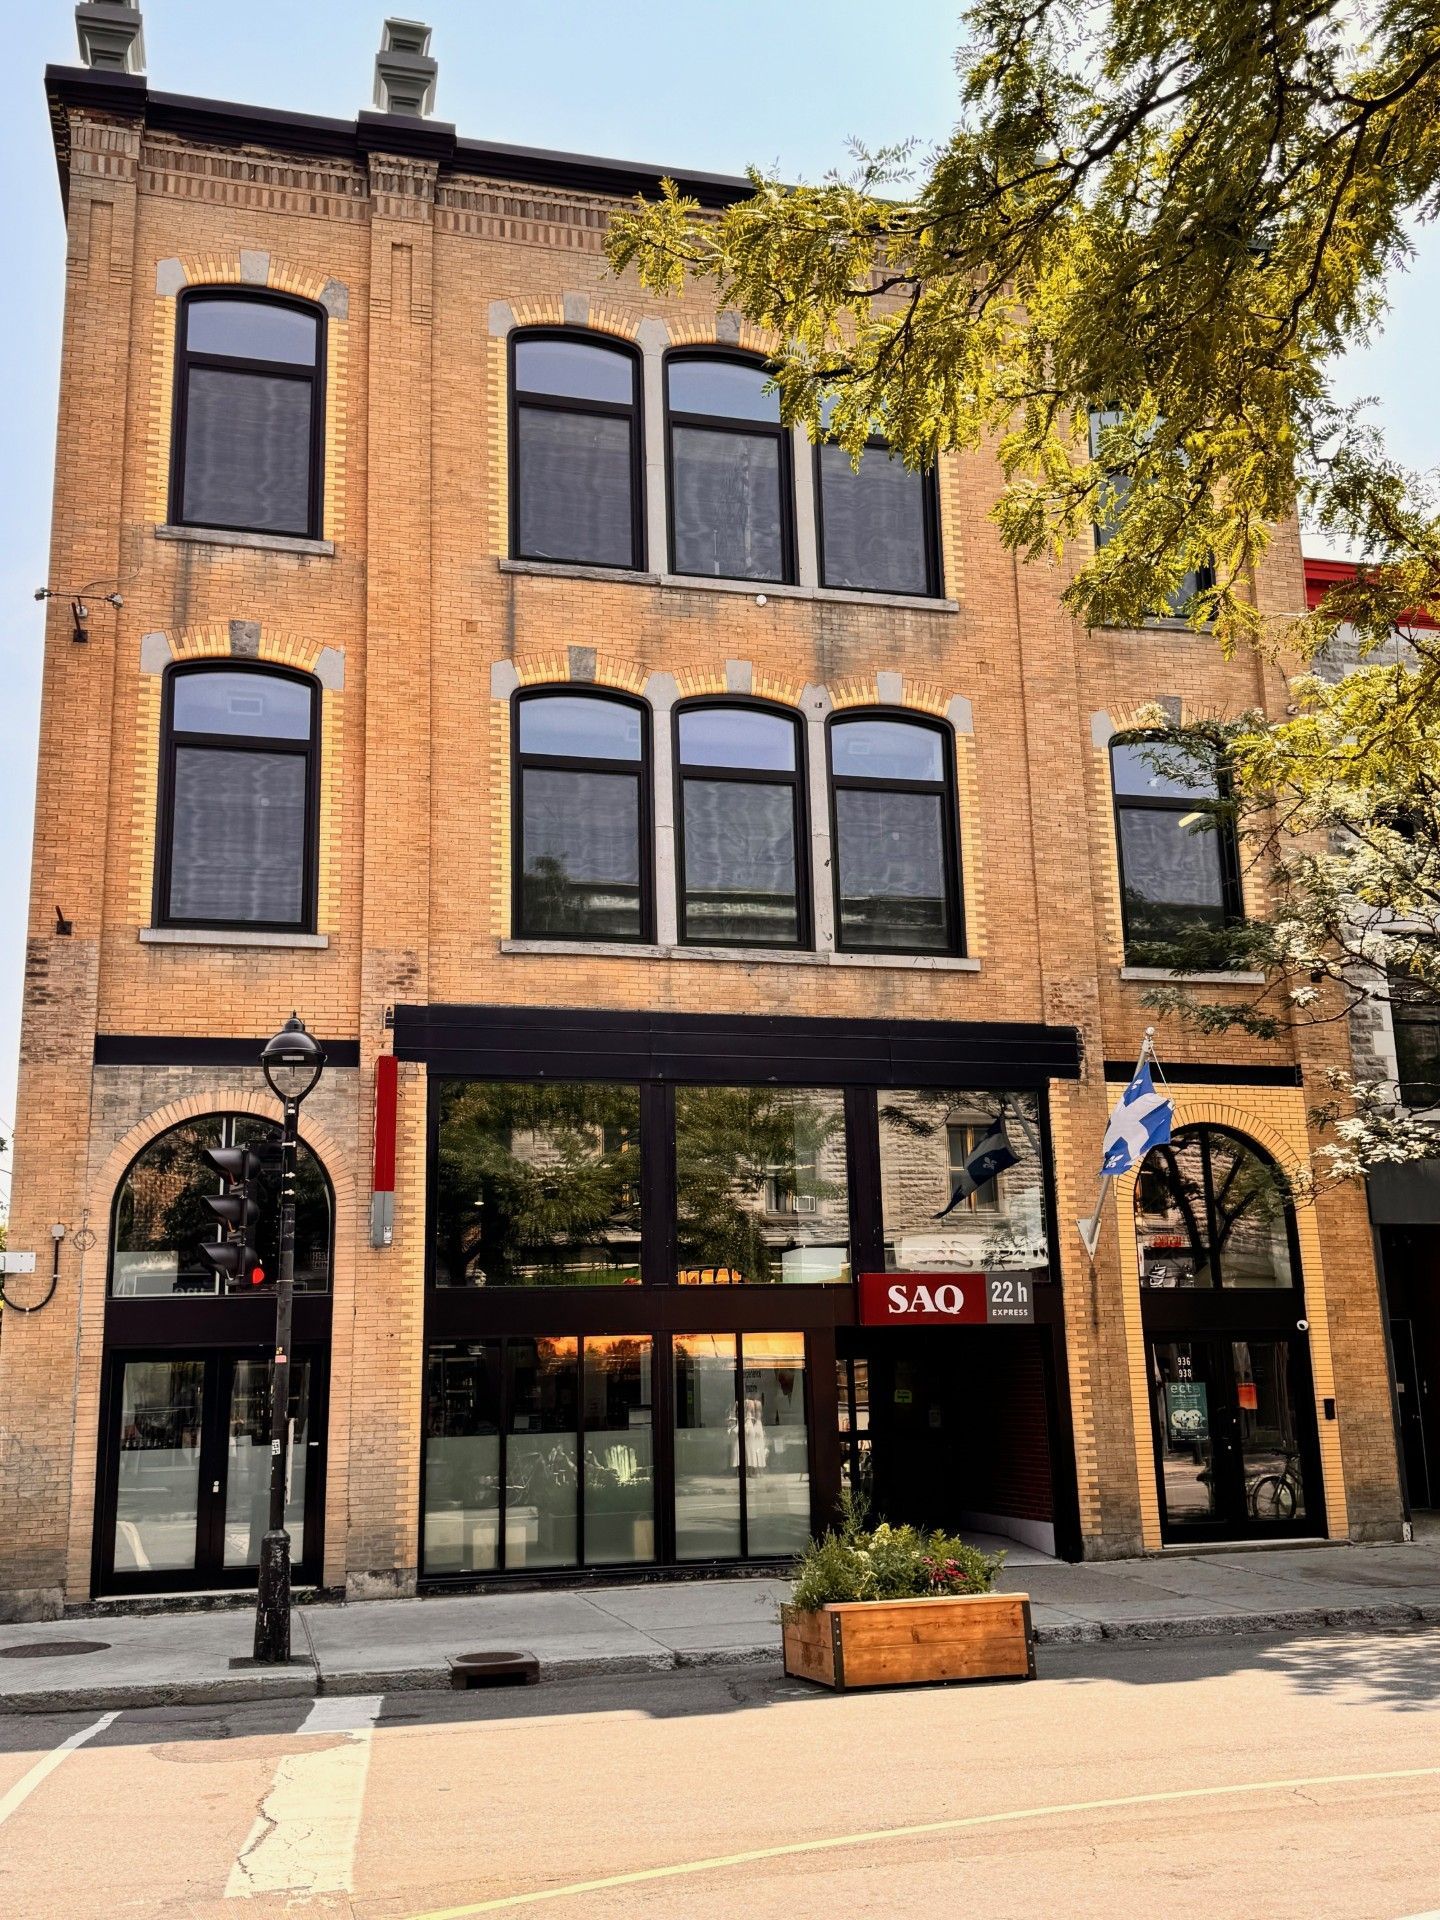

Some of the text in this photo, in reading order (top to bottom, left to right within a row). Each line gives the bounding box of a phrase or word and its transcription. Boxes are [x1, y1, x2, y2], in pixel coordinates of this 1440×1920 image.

[888, 1285, 964, 1314] SAQ
[991, 1281, 1028, 1303] 22 h
[1177, 1357, 1191, 1366] 936
[1179, 1369, 1192, 1378] 938
